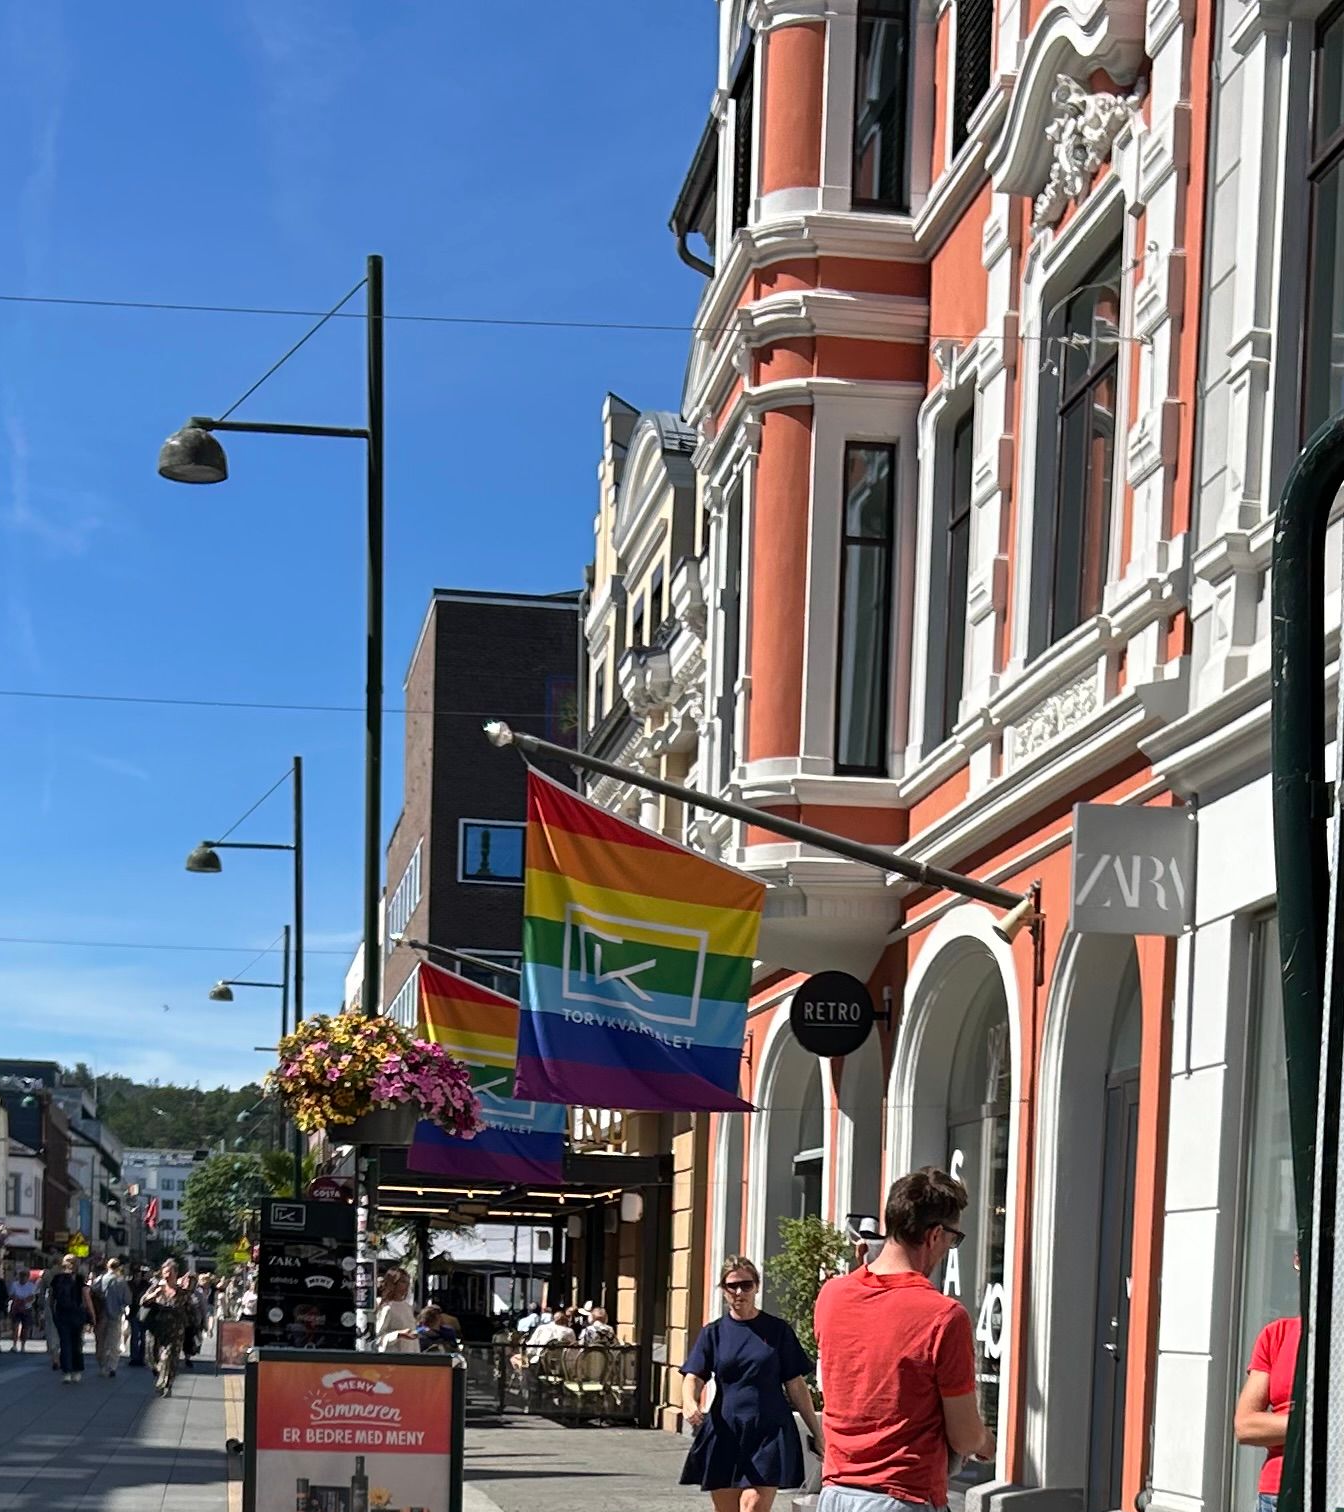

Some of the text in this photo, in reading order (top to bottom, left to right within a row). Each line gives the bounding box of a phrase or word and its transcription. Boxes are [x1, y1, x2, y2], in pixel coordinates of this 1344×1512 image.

[1075, 853, 1186, 911] ZARA
[804, 1002, 861, 1021] RETRO
[561, 1008, 696, 1050] TORVKVARTALET
[313, 1189, 342, 1198] COSTA
[268, 1255, 302, 1268] ZARA
[337, 1380, 374, 1392] MENY
[309, 1399, 403, 1422] Sommeren
[282, 1427, 425, 1446] ER BEDRE MED MENY
